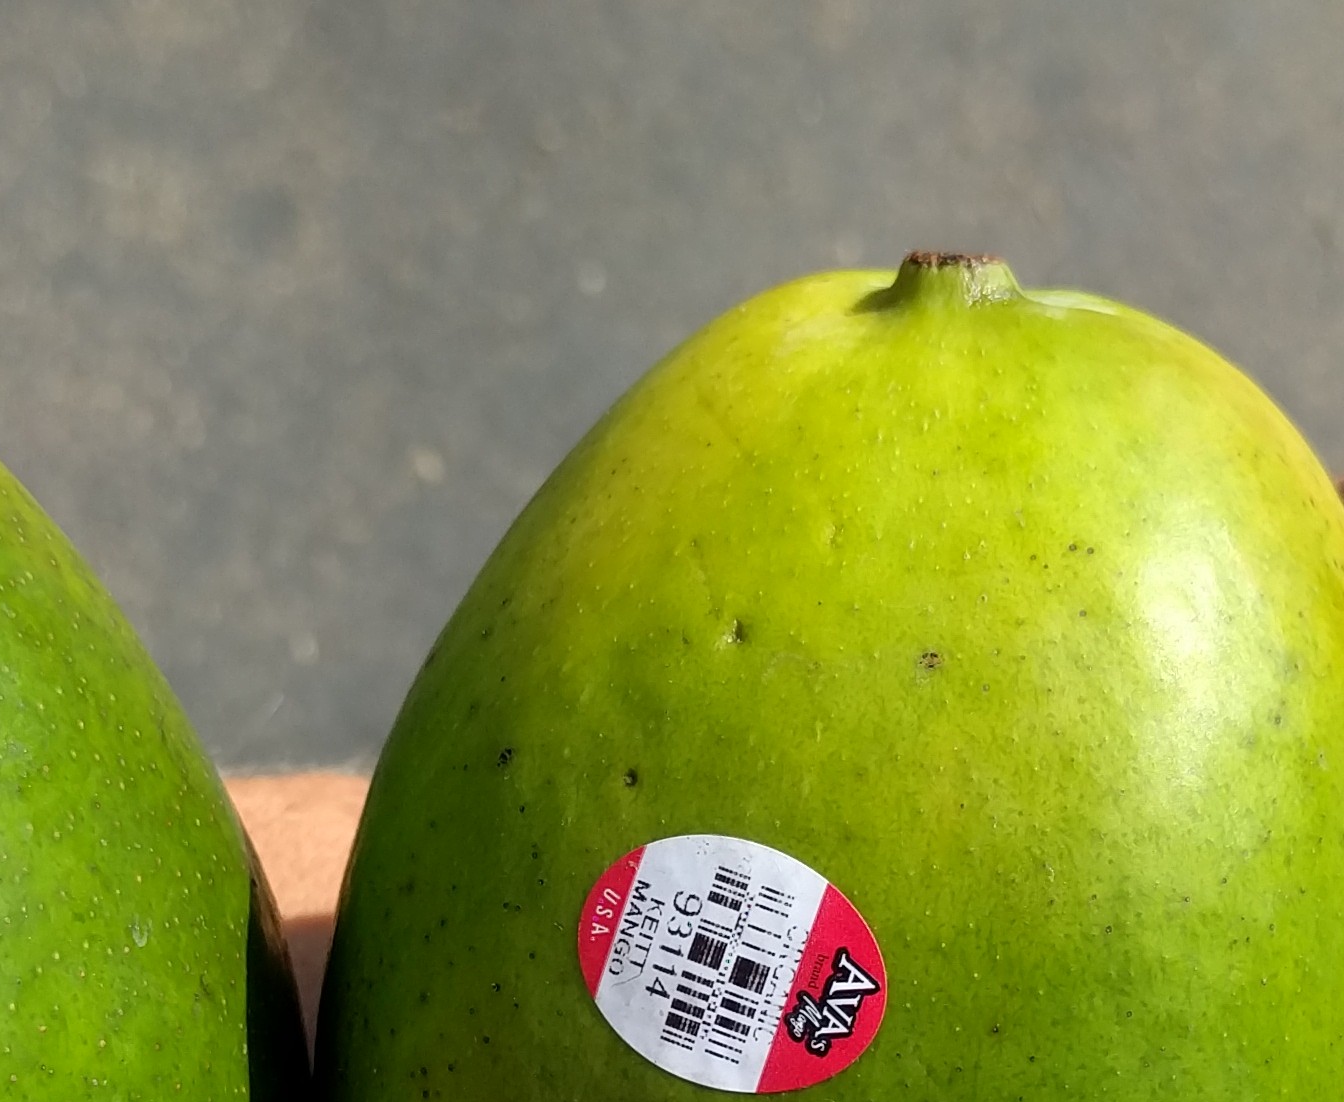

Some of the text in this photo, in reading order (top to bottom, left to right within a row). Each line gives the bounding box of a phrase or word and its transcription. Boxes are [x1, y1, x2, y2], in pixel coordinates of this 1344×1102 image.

[608, 880, 651, 975] MANGO
[629, 897, 666, 967] KEITT
[645, 890, 704, 998] 93114
[810, 954, 829, 991] brand
